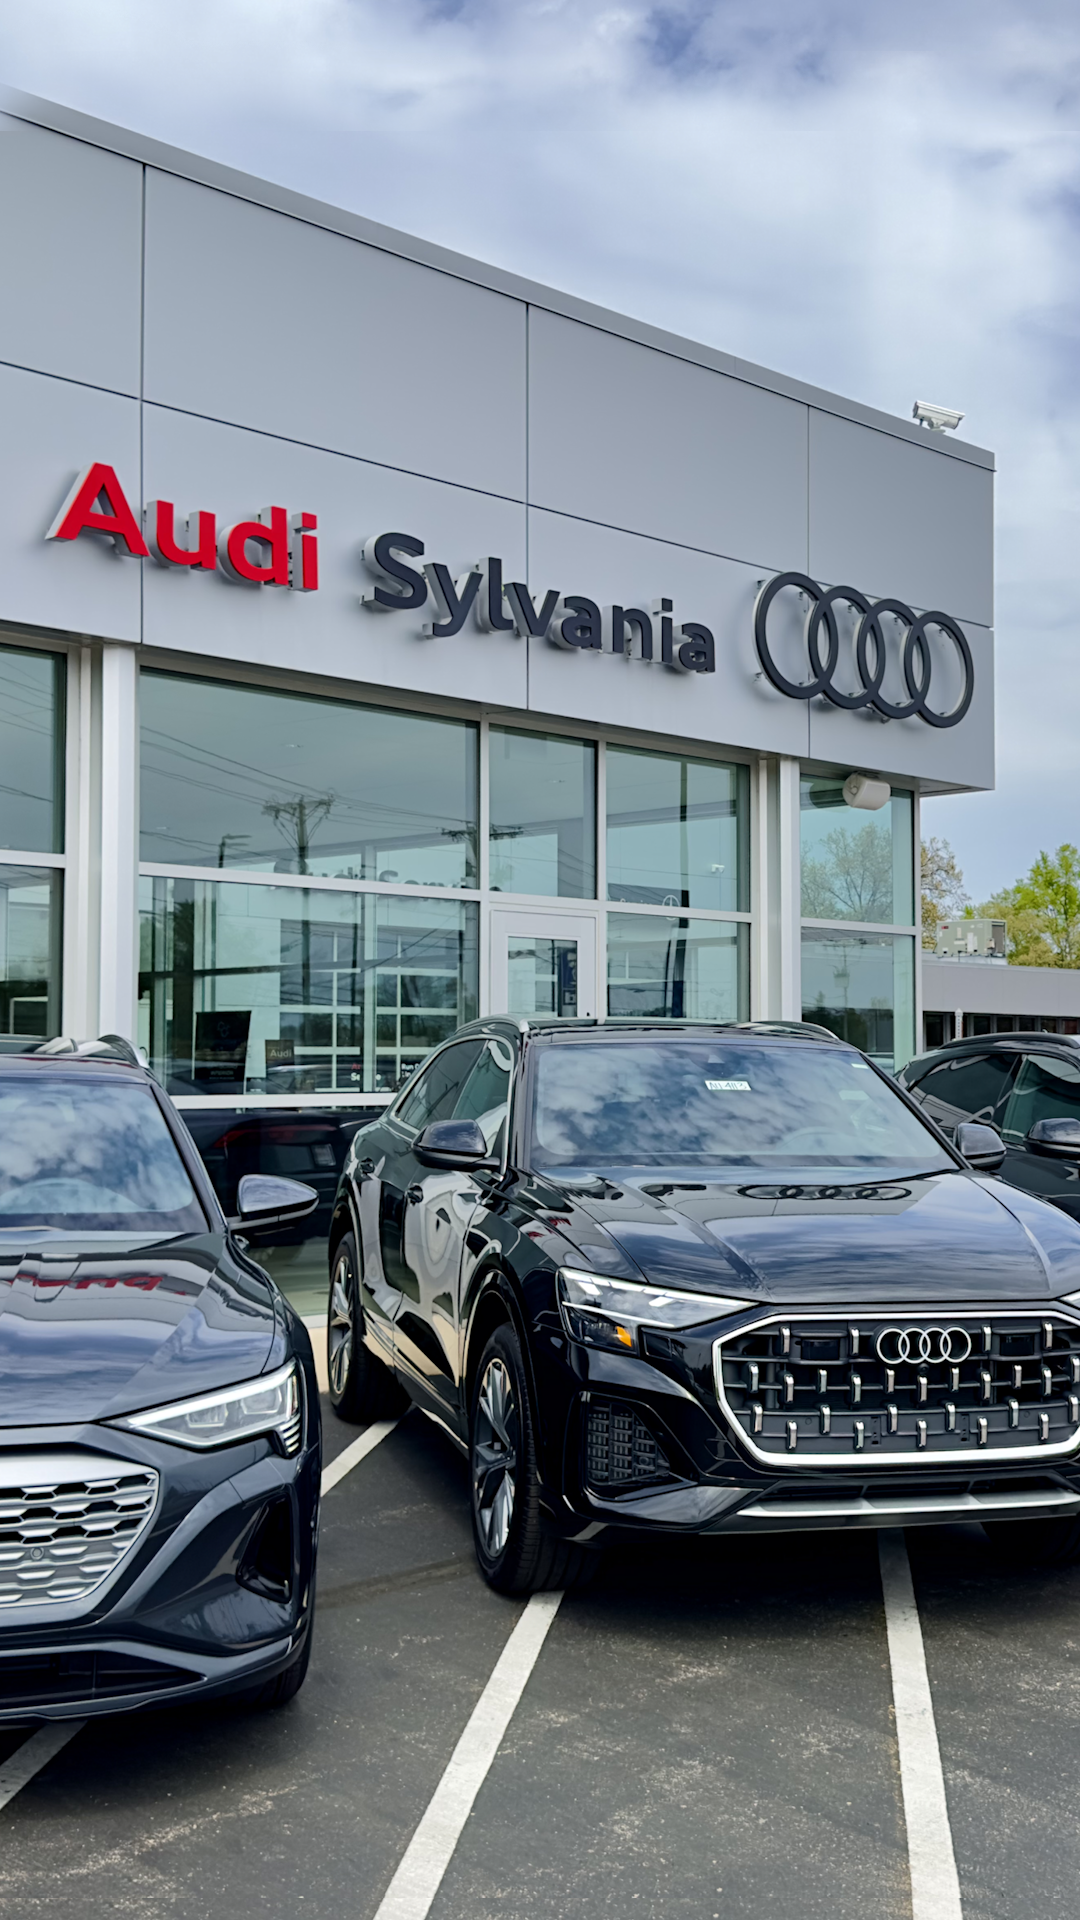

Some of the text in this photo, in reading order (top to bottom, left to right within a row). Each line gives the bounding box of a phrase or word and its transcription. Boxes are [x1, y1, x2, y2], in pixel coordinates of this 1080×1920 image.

[48, 462, 716, 674] Audi Sylvania
[269, 1049, 292, 1058] Audi
